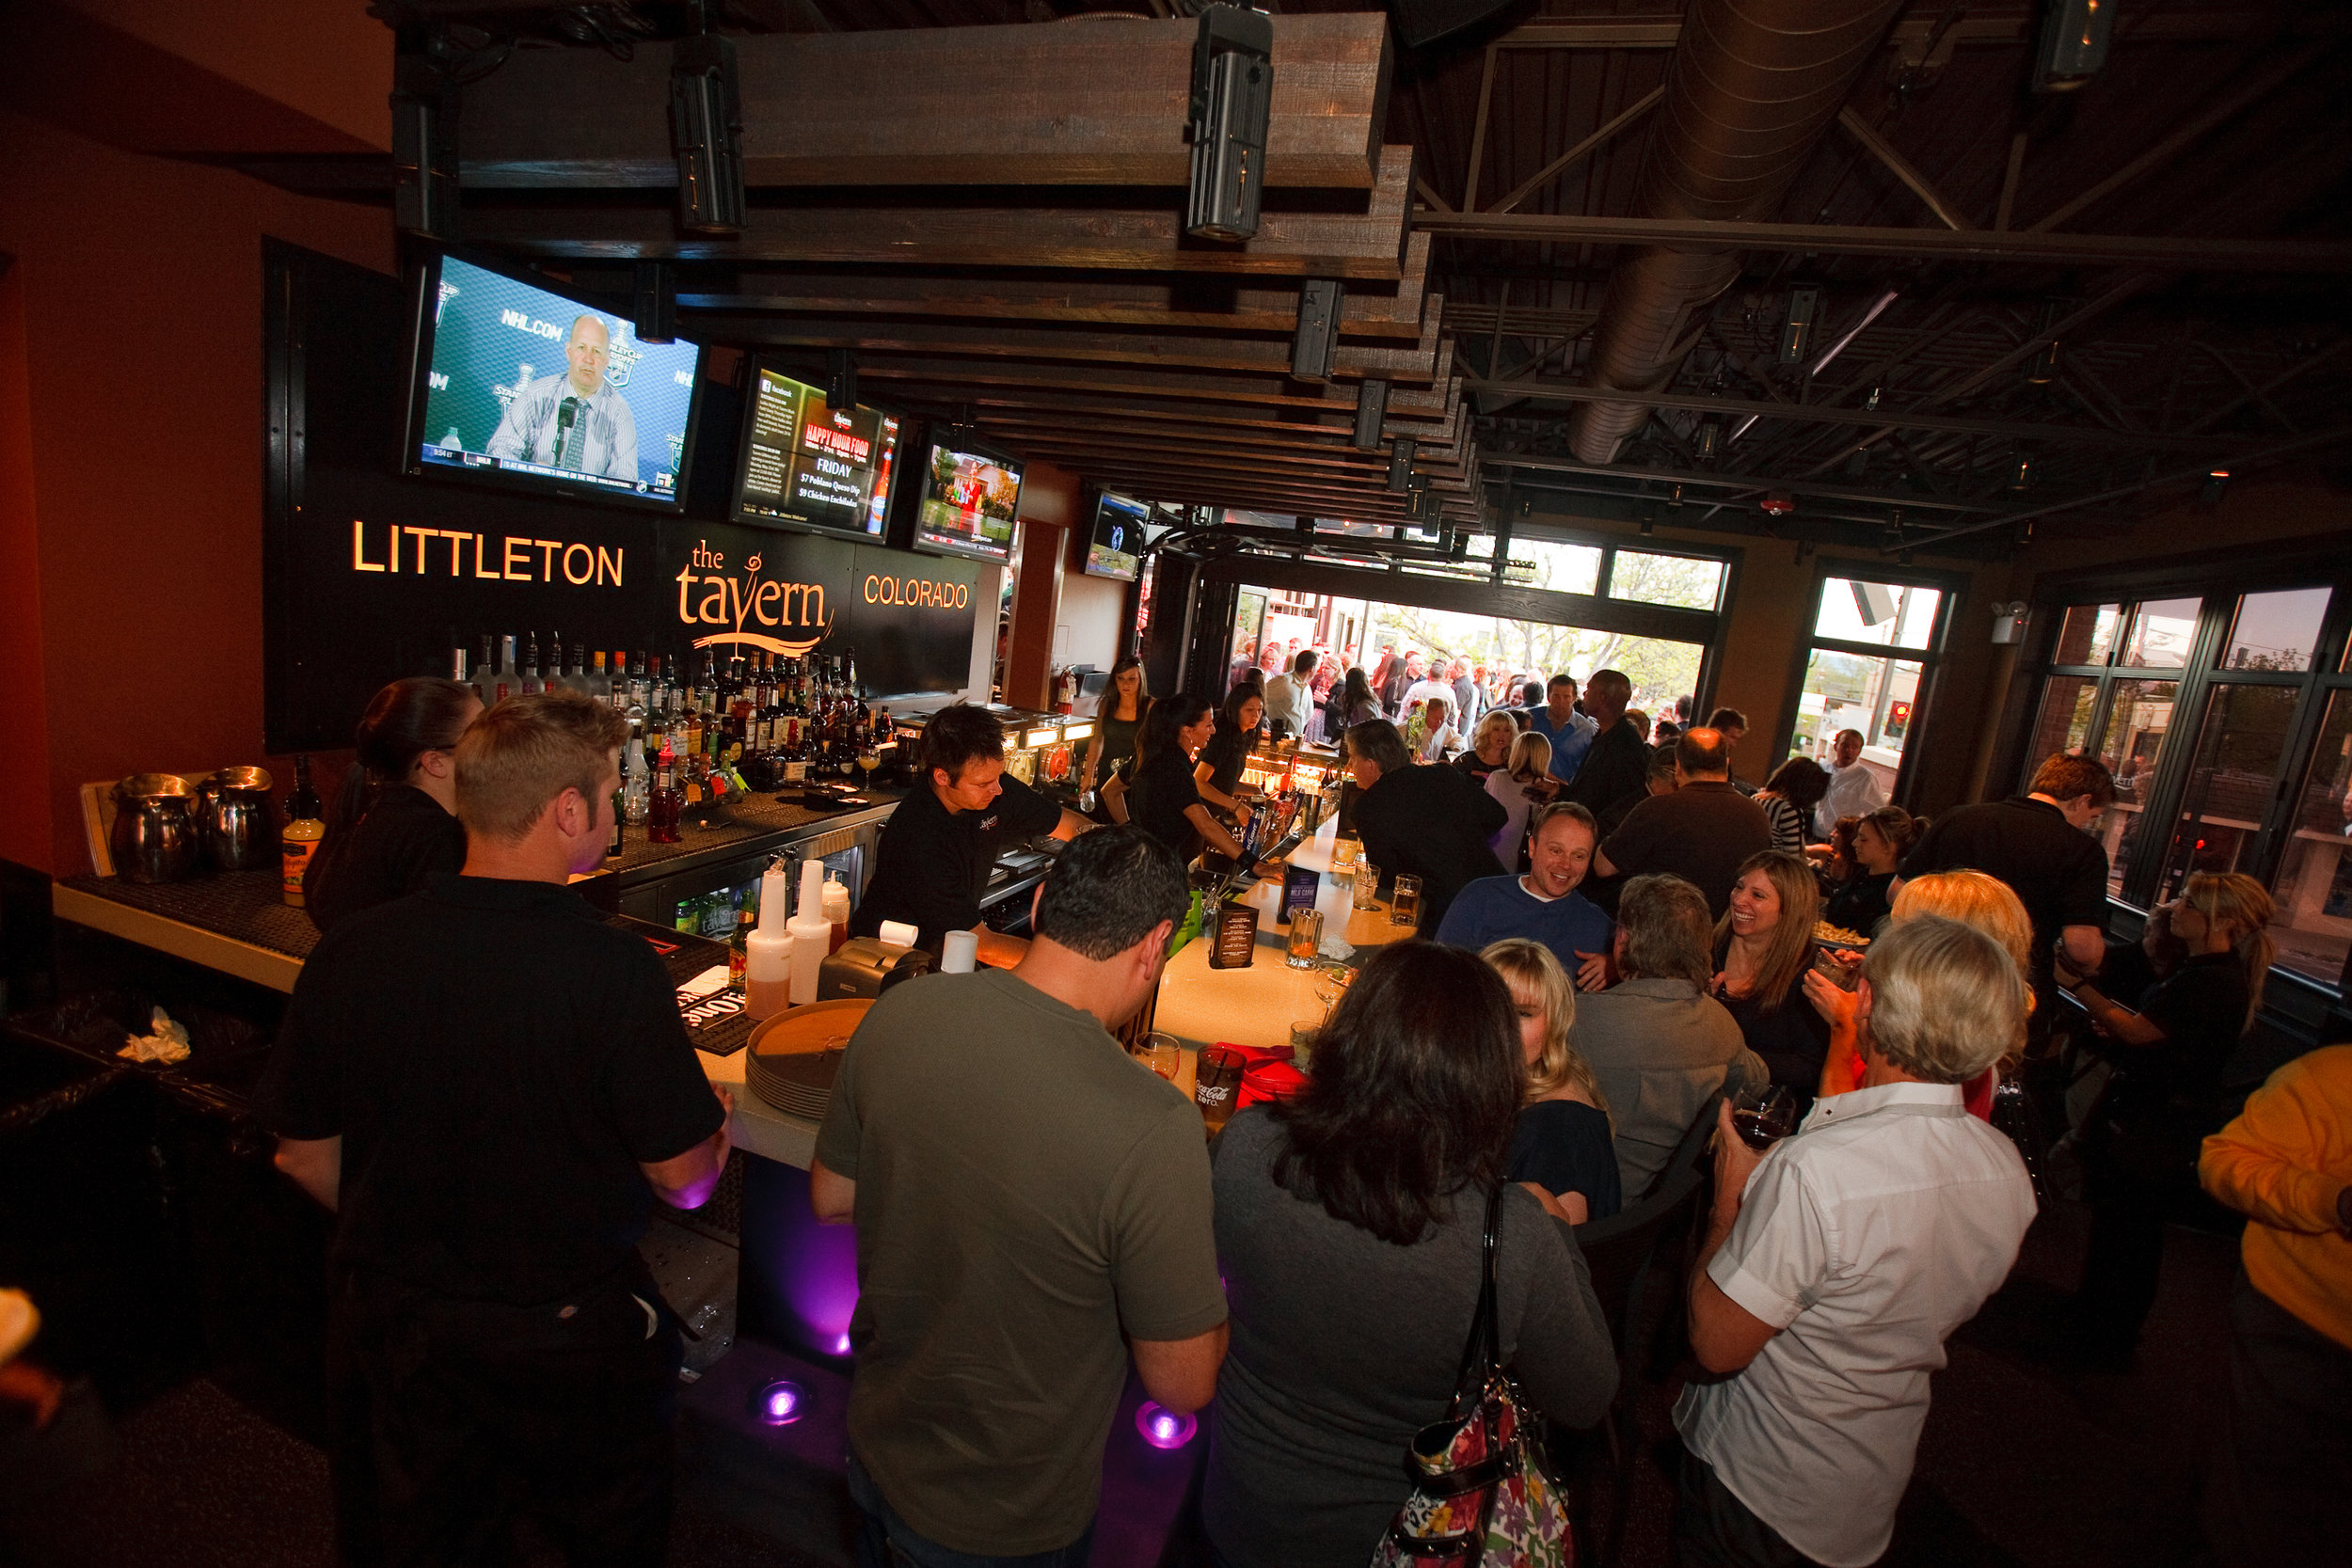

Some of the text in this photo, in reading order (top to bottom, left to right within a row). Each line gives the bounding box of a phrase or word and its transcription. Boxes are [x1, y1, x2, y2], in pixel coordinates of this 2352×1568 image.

[501, 309, 564, 342] NHL.COM
[805, 424, 833, 446] HAPPY
[831, 431, 851, 452] HOUR
[850, 436, 869, 457] FOOD
[817, 457, 852, 479] FRIDAY
[801, 473, 861, 498] $7 Poblano Queso Dip
[807, 489, 830, 503] Chicken
[830, 495, 858, 509] Enchiladas
[354, 520, 624, 587] LITTLETON
[691, 539, 724, 570] the
[675, 562, 826, 635] tavern
[864, 574, 969, 610] COLORADO
[1196, 1079, 1232, 1101] Coca-Cola
